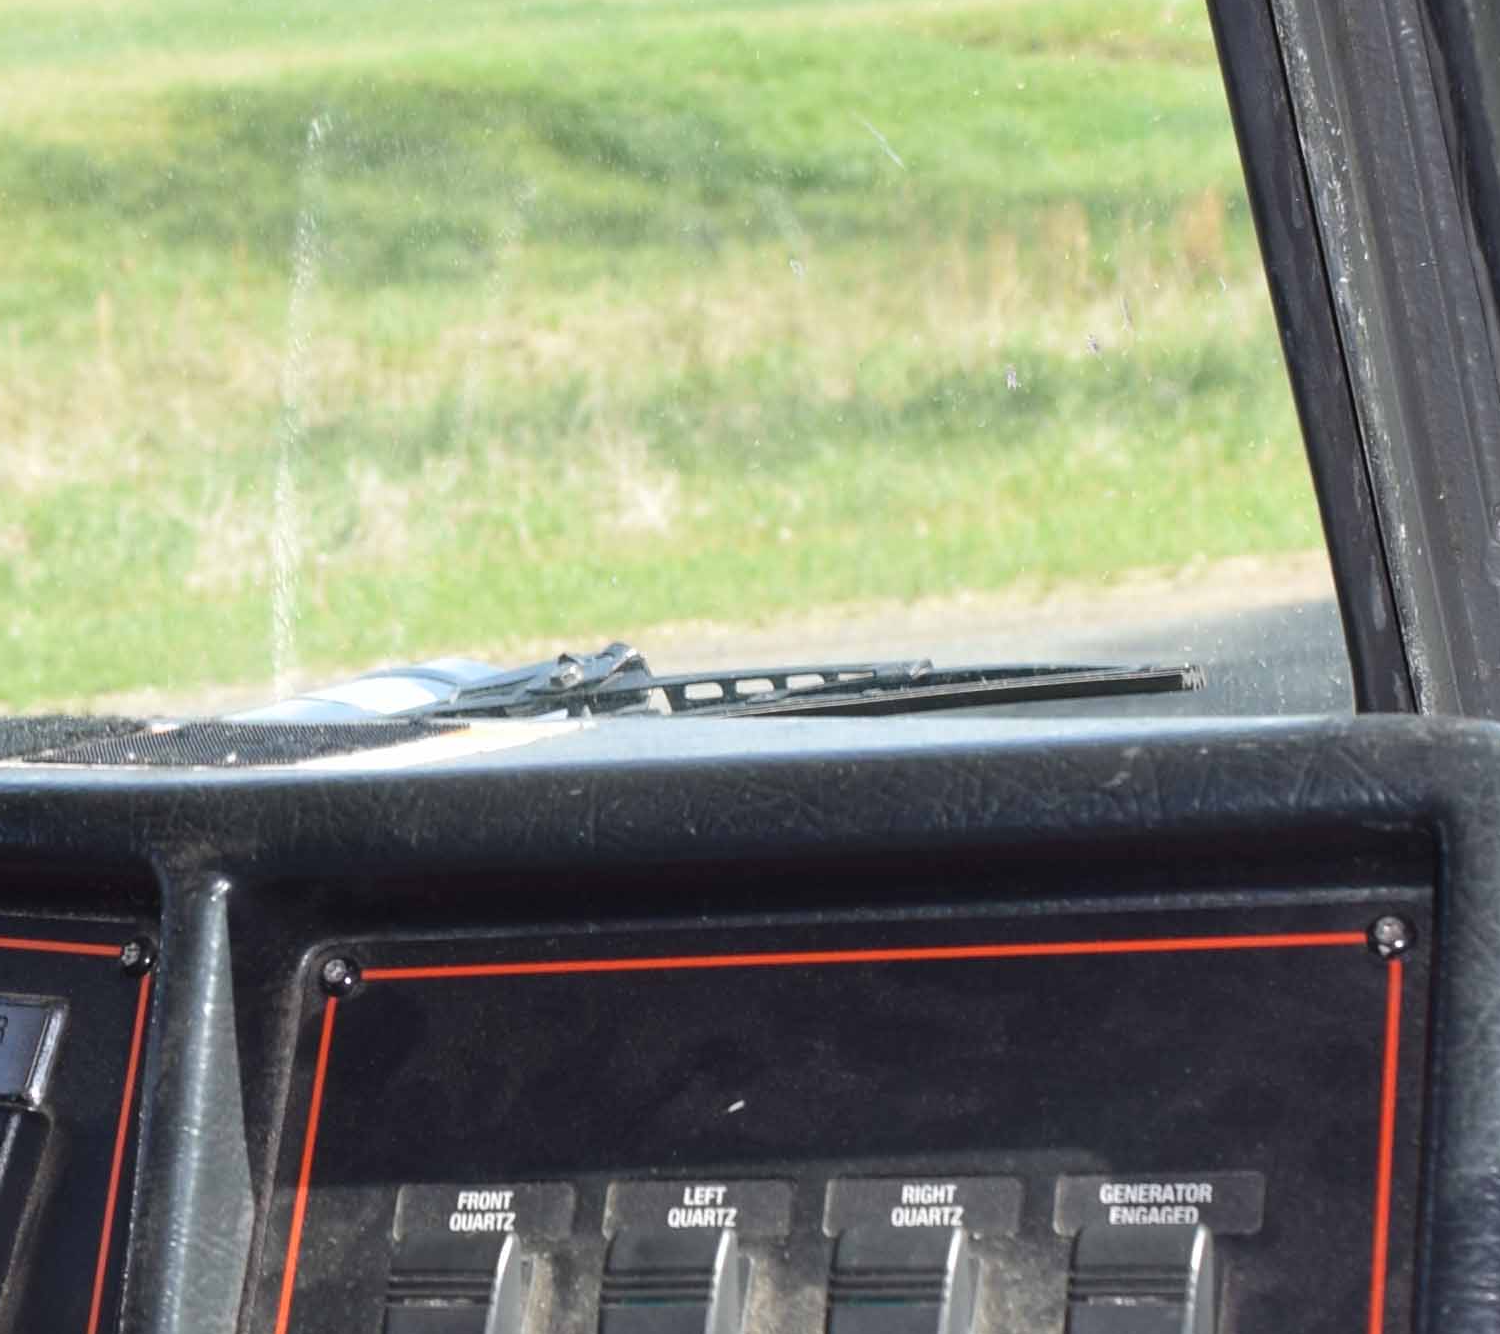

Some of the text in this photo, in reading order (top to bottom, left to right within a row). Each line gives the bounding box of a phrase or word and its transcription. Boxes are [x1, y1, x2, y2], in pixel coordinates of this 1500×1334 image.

[457, 1190, 515, 1211] FRONT
[683, 1186, 727, 1207] LEFT
[901, 1184, 958, 1205] RIGHT
[1099, 1183, 1214, 1205] GENERATOR
[449, 1212, 517, 1232] QUARTZ
[667, 1207, 739, 1229] QUARTZ
[891, 1206, 964, 1227] QUARTZ
[1108, 1205, 1200, 1225] ENGAGED
